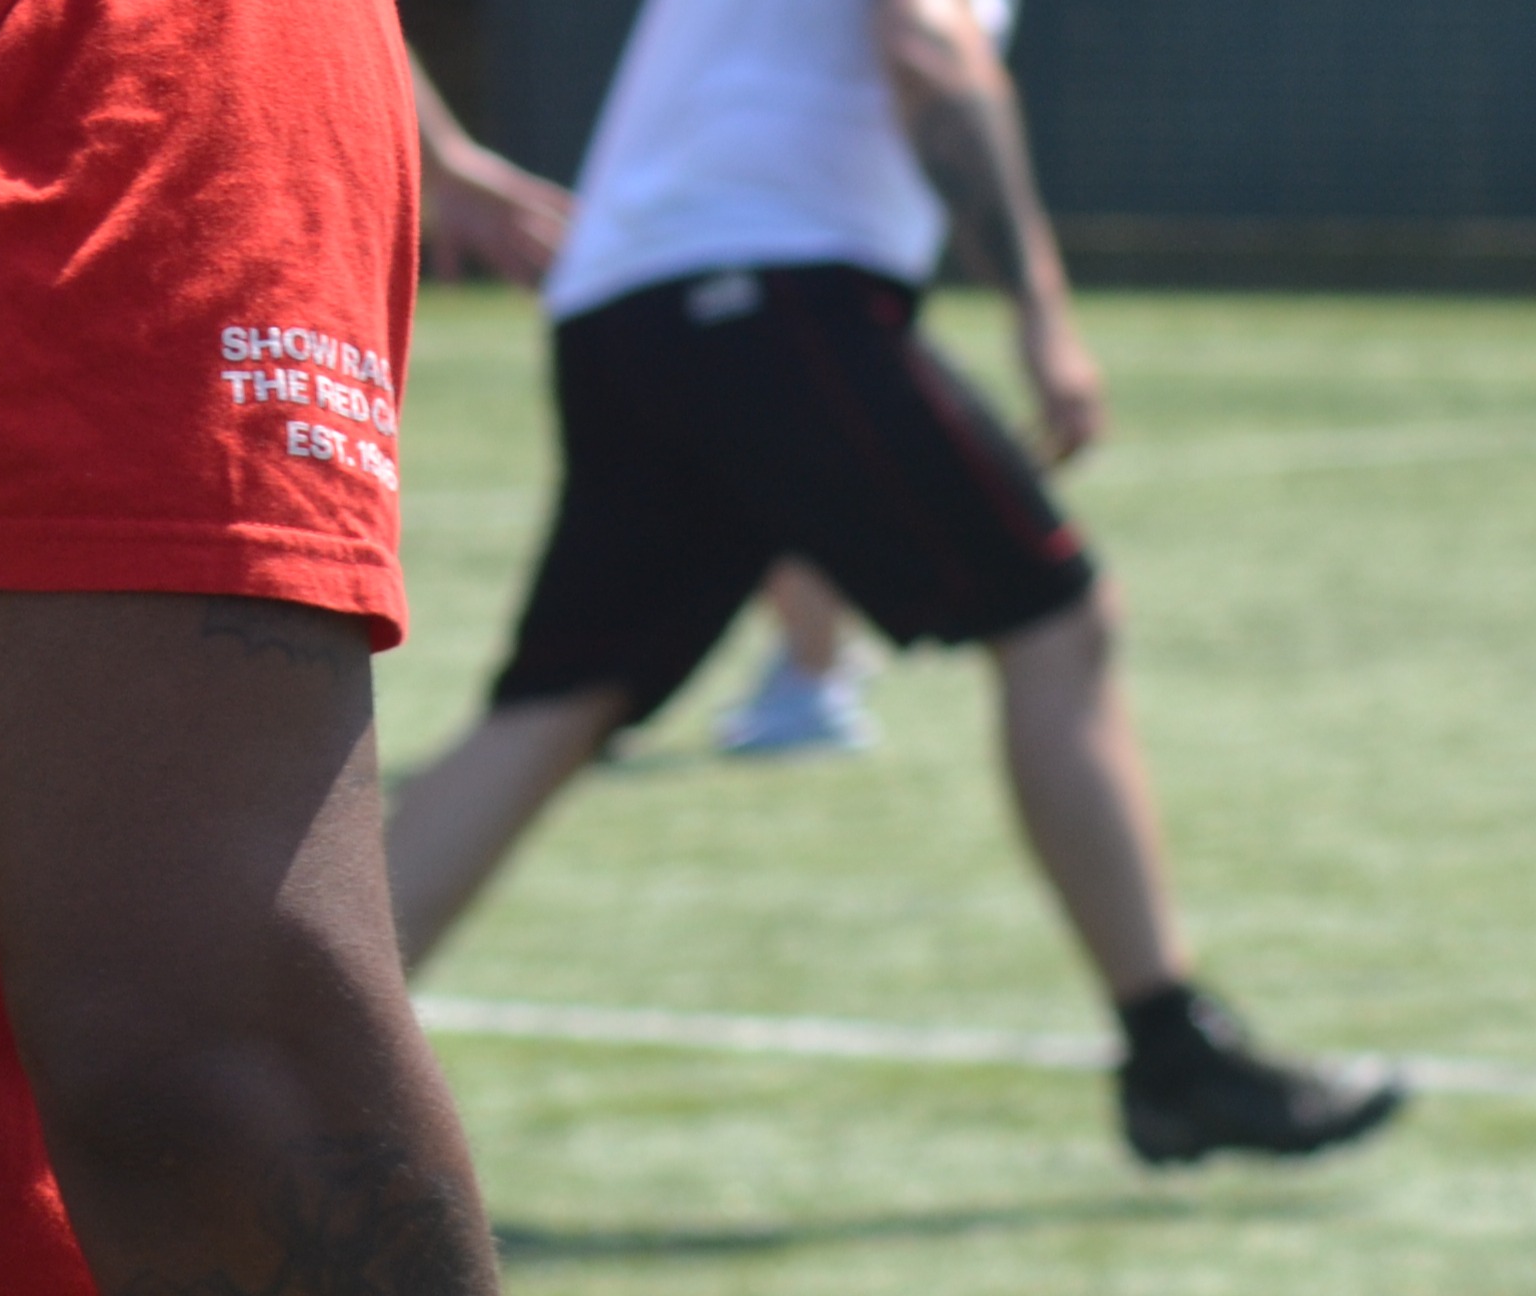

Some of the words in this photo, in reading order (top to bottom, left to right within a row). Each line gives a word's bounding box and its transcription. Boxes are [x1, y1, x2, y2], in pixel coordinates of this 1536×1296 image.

[220, 325, 338, 370] SHOW
[220, 368, 310, 404] THE
[315, 375, 371, 422] RED
[286, 420, 356, 467] EST.
